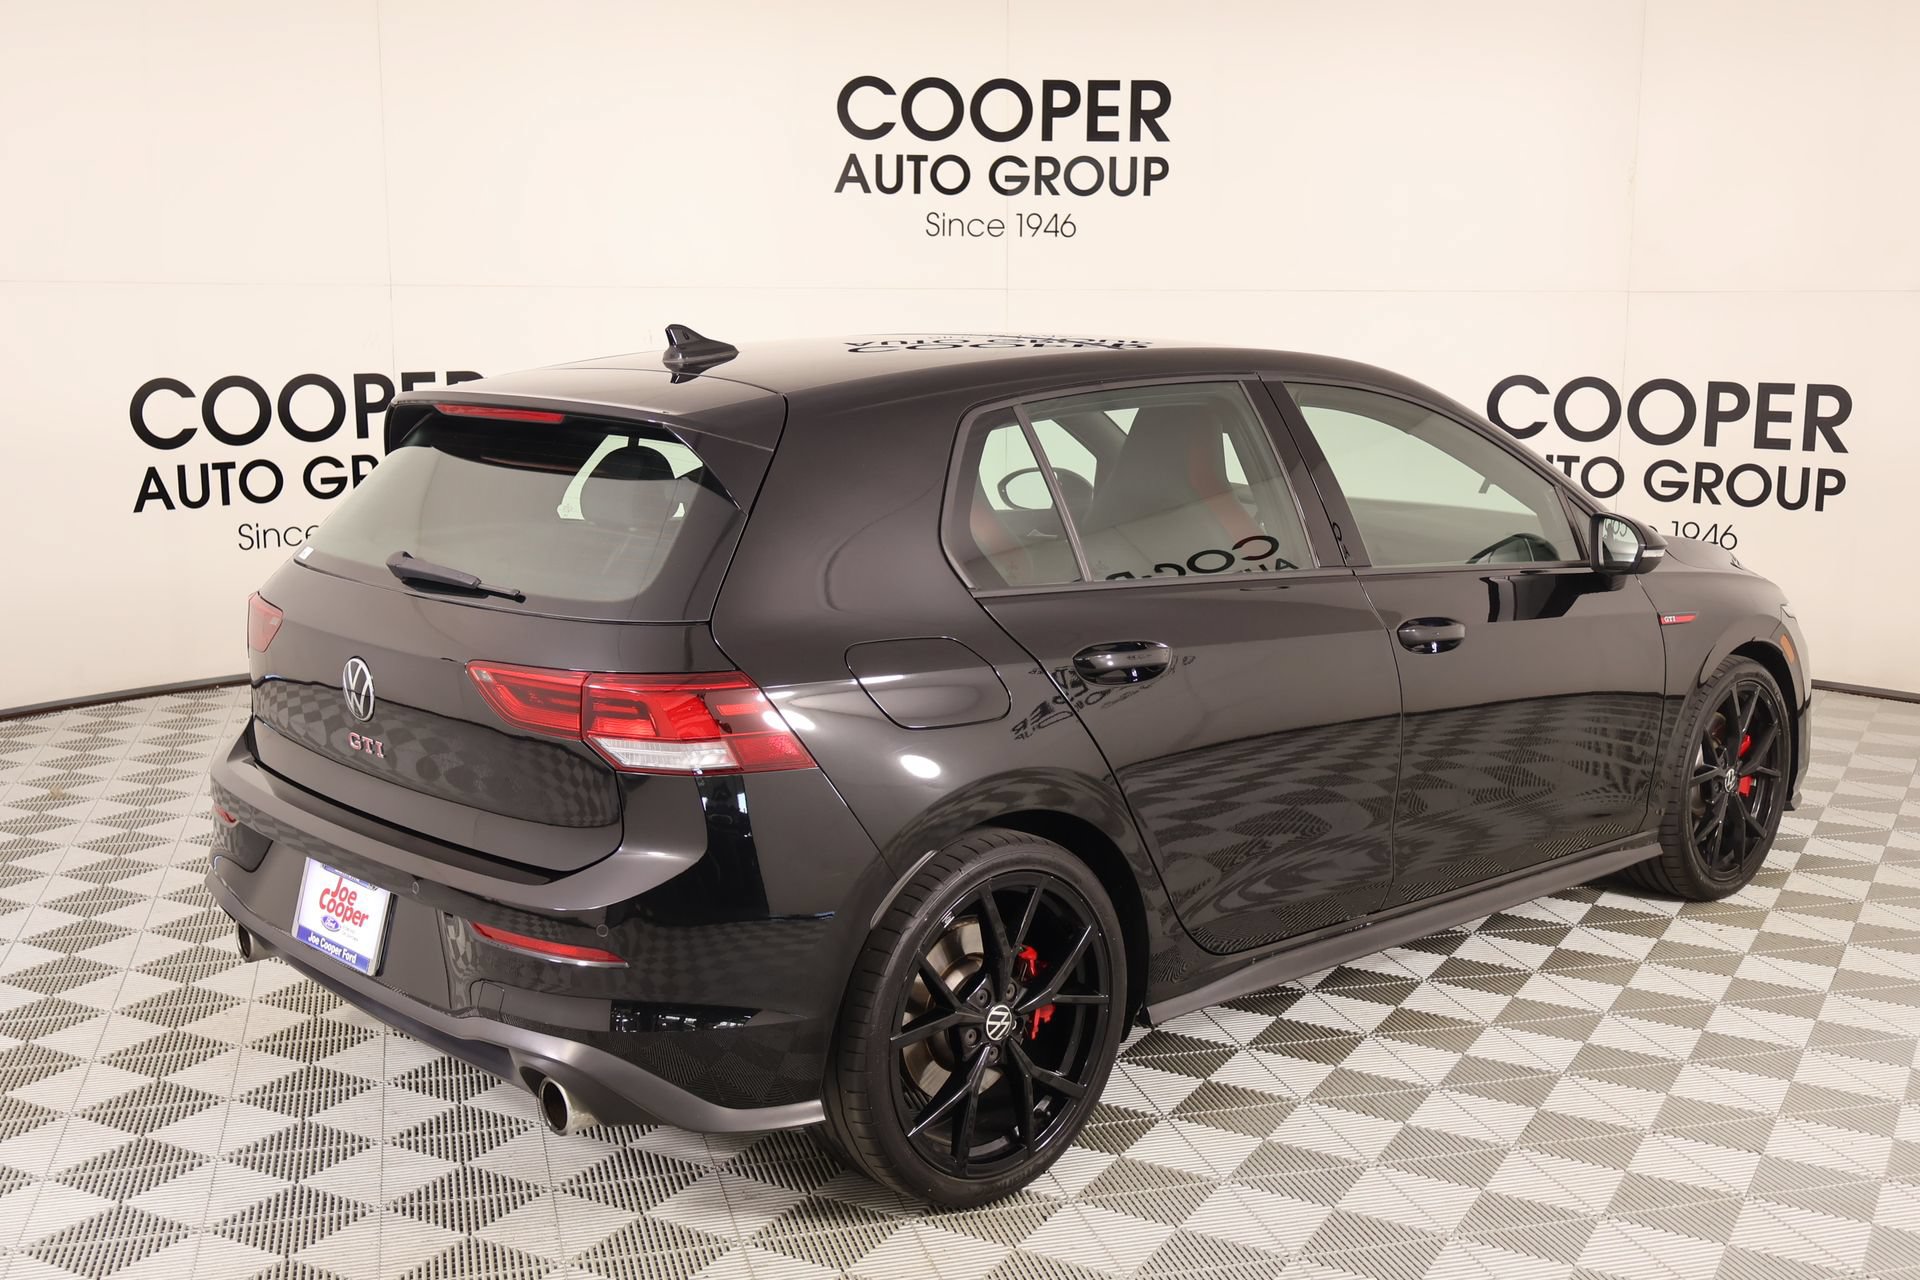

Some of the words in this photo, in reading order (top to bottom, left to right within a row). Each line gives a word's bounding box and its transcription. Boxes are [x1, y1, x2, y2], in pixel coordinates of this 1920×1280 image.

[837, 76, 1171, 142] COOPER
[834, 153, 971, 195] AUTO
[989, 155, 1170, 197] GROUP
[926, 212, 1005, 237] Since
[1016, 213, 1077, 237] 1946
[129, 371, 483, 450] COOP
[1487, 374, 1853, 453] COOPER
[133, 459, 284, 513] AUTO
[1644, 459, 1846, 512] GROUP
[348, 731, 385, 759] GTI
[319, 888, 369, 927] Cooper
[331, 877, 358, 906] Joe
[308, 931, 319, 946] Joe
[319, 937, 342, 956] Cooper
[341, 948, 358, 965] Ford
